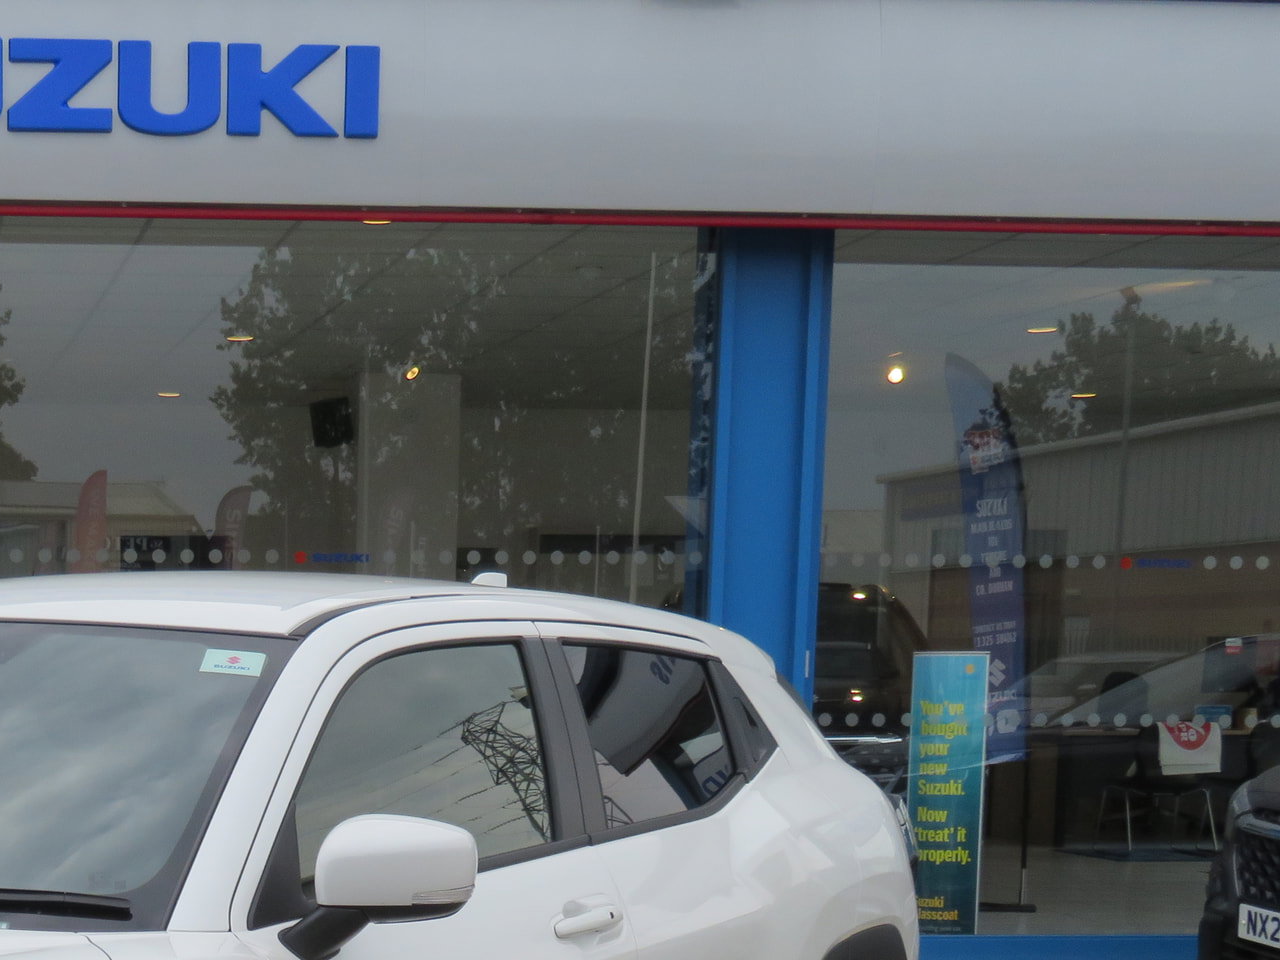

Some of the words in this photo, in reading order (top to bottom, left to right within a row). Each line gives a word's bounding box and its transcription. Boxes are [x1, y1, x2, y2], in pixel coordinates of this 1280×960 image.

[919, 700, 964, 716] You've
[921, 720, 967, 739] bought
[919, 743, 950, 758] your
[919, 763, 948, 775] new
[918, 779, 966, 795] Suzuki.
[917, 806, 947, 822] Now
[957, 827, 966, 842] it
[916, 896, 944, 908] uzuki
[918, 909, 959, 920] lasscoat
